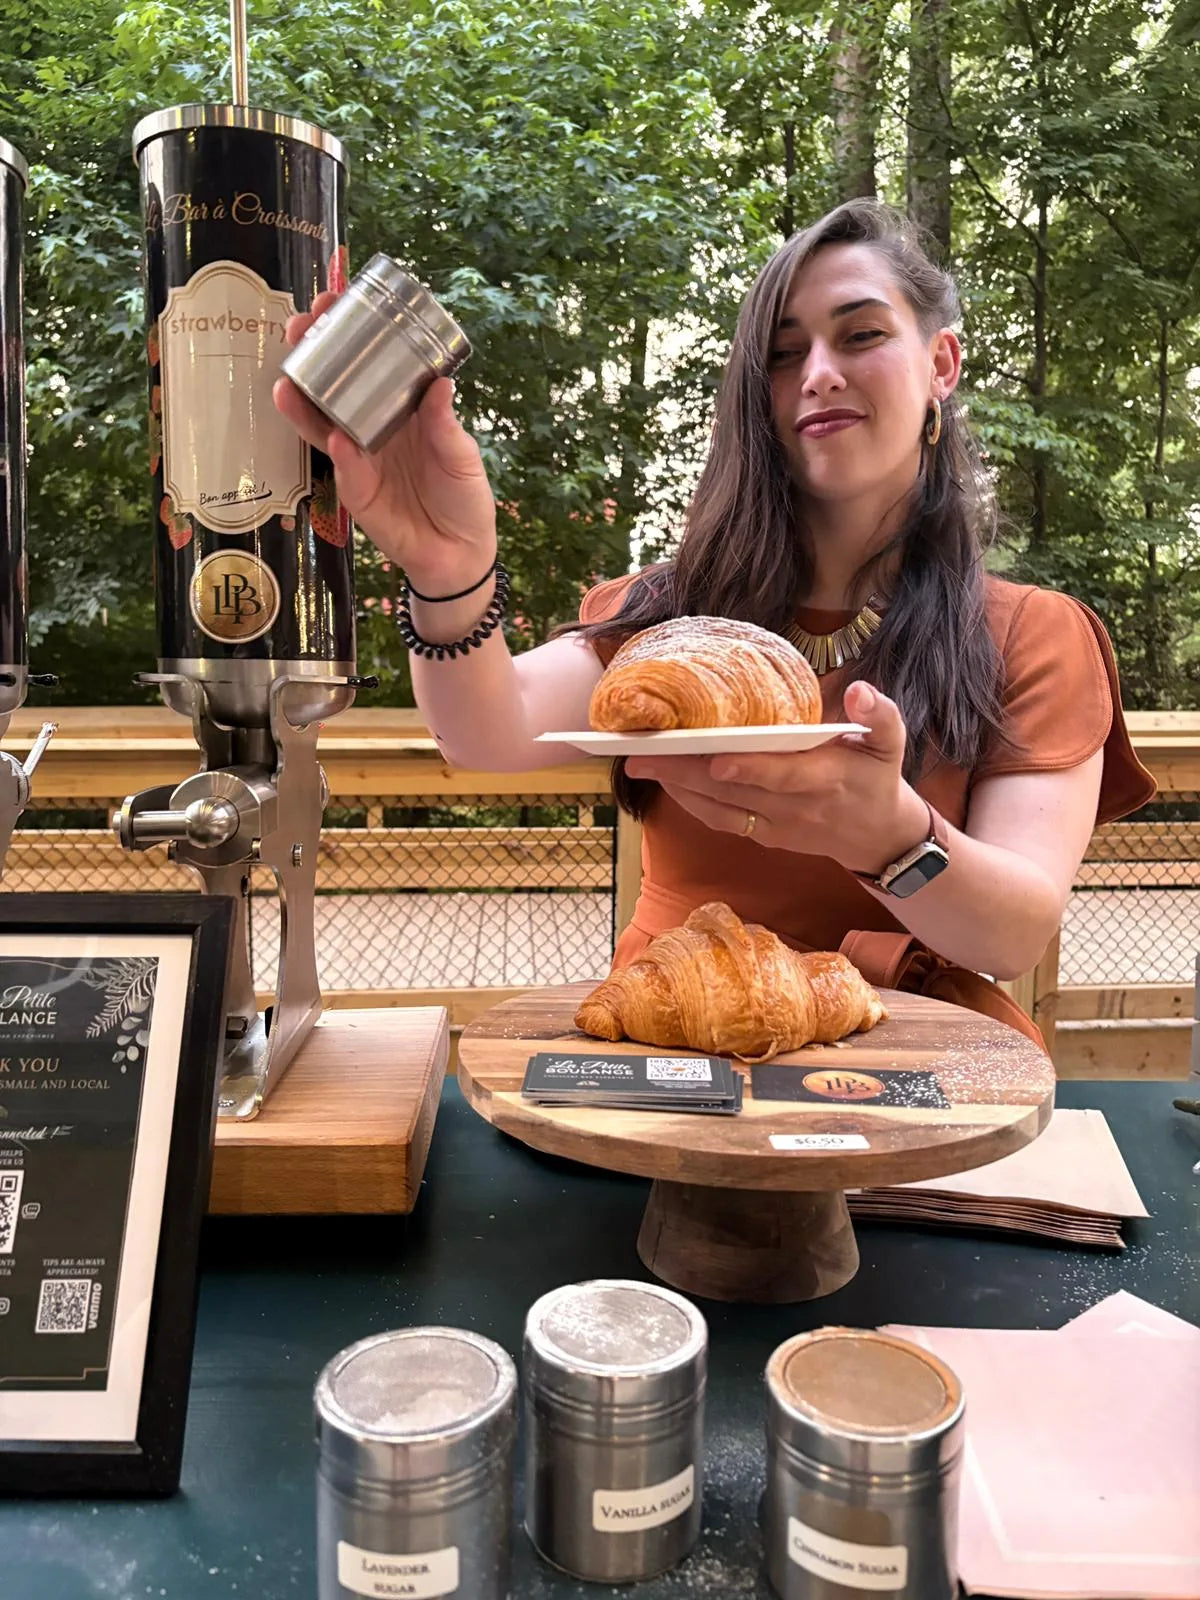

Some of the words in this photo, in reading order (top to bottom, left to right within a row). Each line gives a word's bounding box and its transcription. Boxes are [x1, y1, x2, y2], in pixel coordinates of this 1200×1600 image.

[162, 192, 208, 227] Bar
[212, 197, 227, 220] à
[231, 191, 331, 243] Croissants
[171, 310, 287, 344] strawberry
[199, 492, 220, 506] Bon
[0, 985, 57, 1009] Petite
[0, 1011, 58, 1025] LANGE
[20, 1057, 60, 1073] YOU
[545, 1067, 634, 1076] BOULANGE
[0, 1079, 37, 1090] SMALL
[41, 1079, 67, 1090] AND
[71, 1079, 110, 1090] LOCAL
[42, 1258, 59, 1266] TIPS
[61, 1258, 75, 1266] ARE
[76, 1258, 105, 1266] ALWAYS
[88, 1282, 102, 1330] venmo
[601, 1504, 658, 1519] VANILLA
[660, 1485, 691, 1511] SUGAR
[361, 1558, 431, 1576] LAVENDER
[858, 1562, 898, 1575] SUGAR
[374, 1582, 417, 1593] SUGAR
